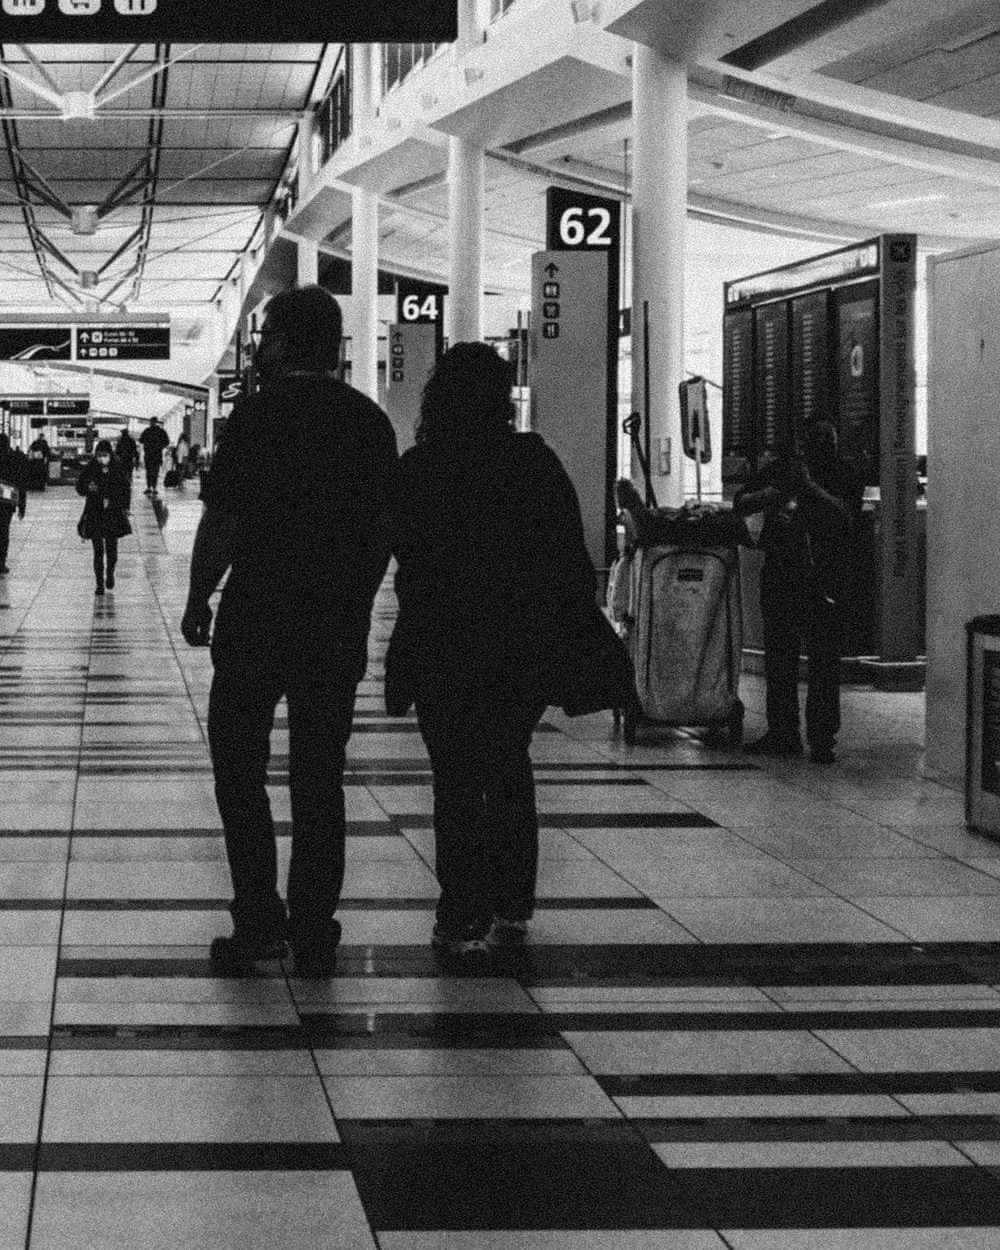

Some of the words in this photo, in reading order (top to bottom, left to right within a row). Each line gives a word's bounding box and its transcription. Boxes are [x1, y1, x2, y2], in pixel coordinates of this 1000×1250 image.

[559, 206, 612, 246] 62
[402, 294, 438, 320] 64
[892, 460, 907, 536] Information
